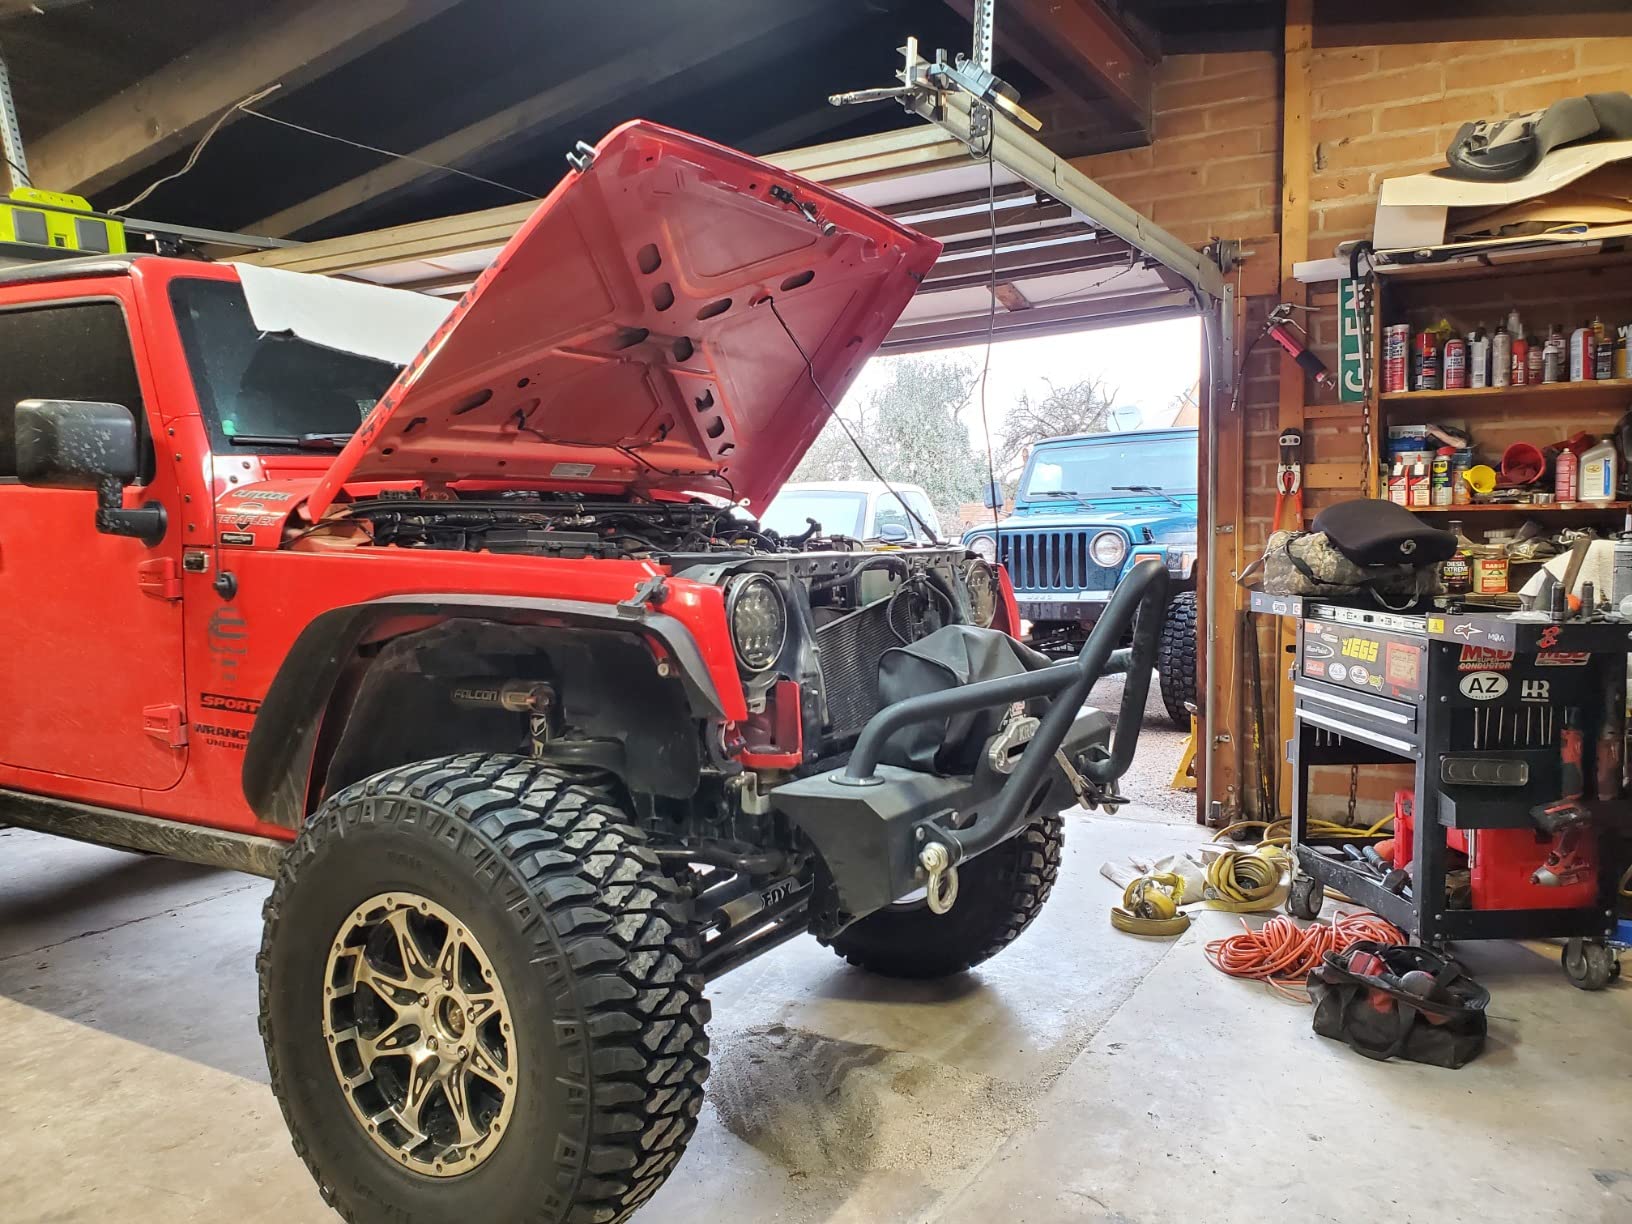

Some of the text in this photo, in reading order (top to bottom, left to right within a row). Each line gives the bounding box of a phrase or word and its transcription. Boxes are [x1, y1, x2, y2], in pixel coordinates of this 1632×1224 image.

[1344, 282, 1374, 393] GLEN
[1341, 637, 1379, 663] JEGS
[1461, 643, 1513, 661] MSD
[1459, 662, 1511, 670] CONDUCTOR
[1468, 677, 1500, 694] AZ
[202, 695, 262, 711] SPORT
[454, 688, 498, 701] FALCON
[761, 881, 792, 908] FOX
